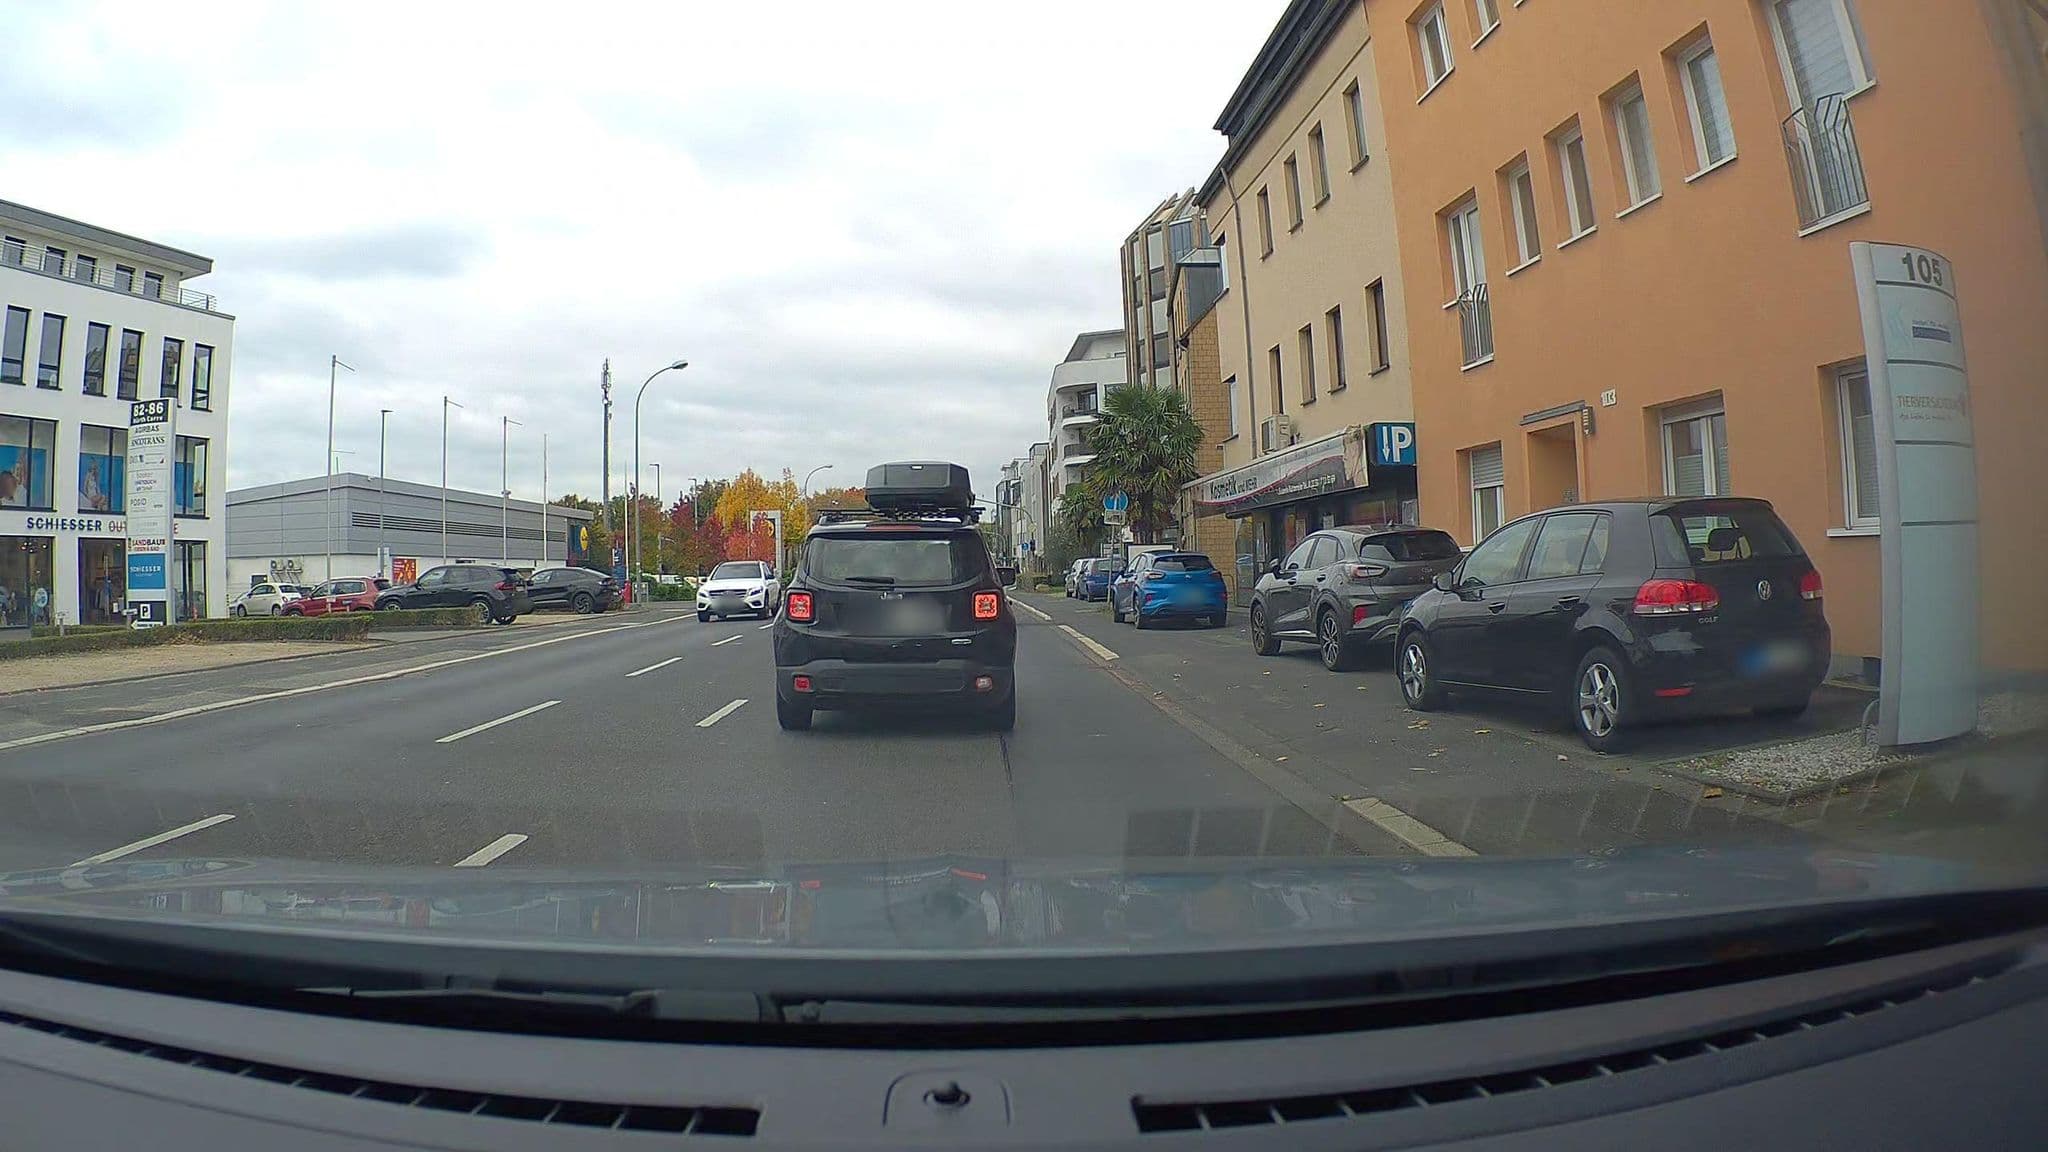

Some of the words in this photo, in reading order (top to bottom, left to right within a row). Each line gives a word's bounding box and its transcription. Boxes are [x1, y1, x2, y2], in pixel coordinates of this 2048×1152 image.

[1902, 252, 1943, 287] 105
[133, 402, 164, 417] 82-86
[1391, 426, 1413, 463] P
[26, 517, 102, 532] SCHIESSER
[108, 520, 127, 533] OUT
